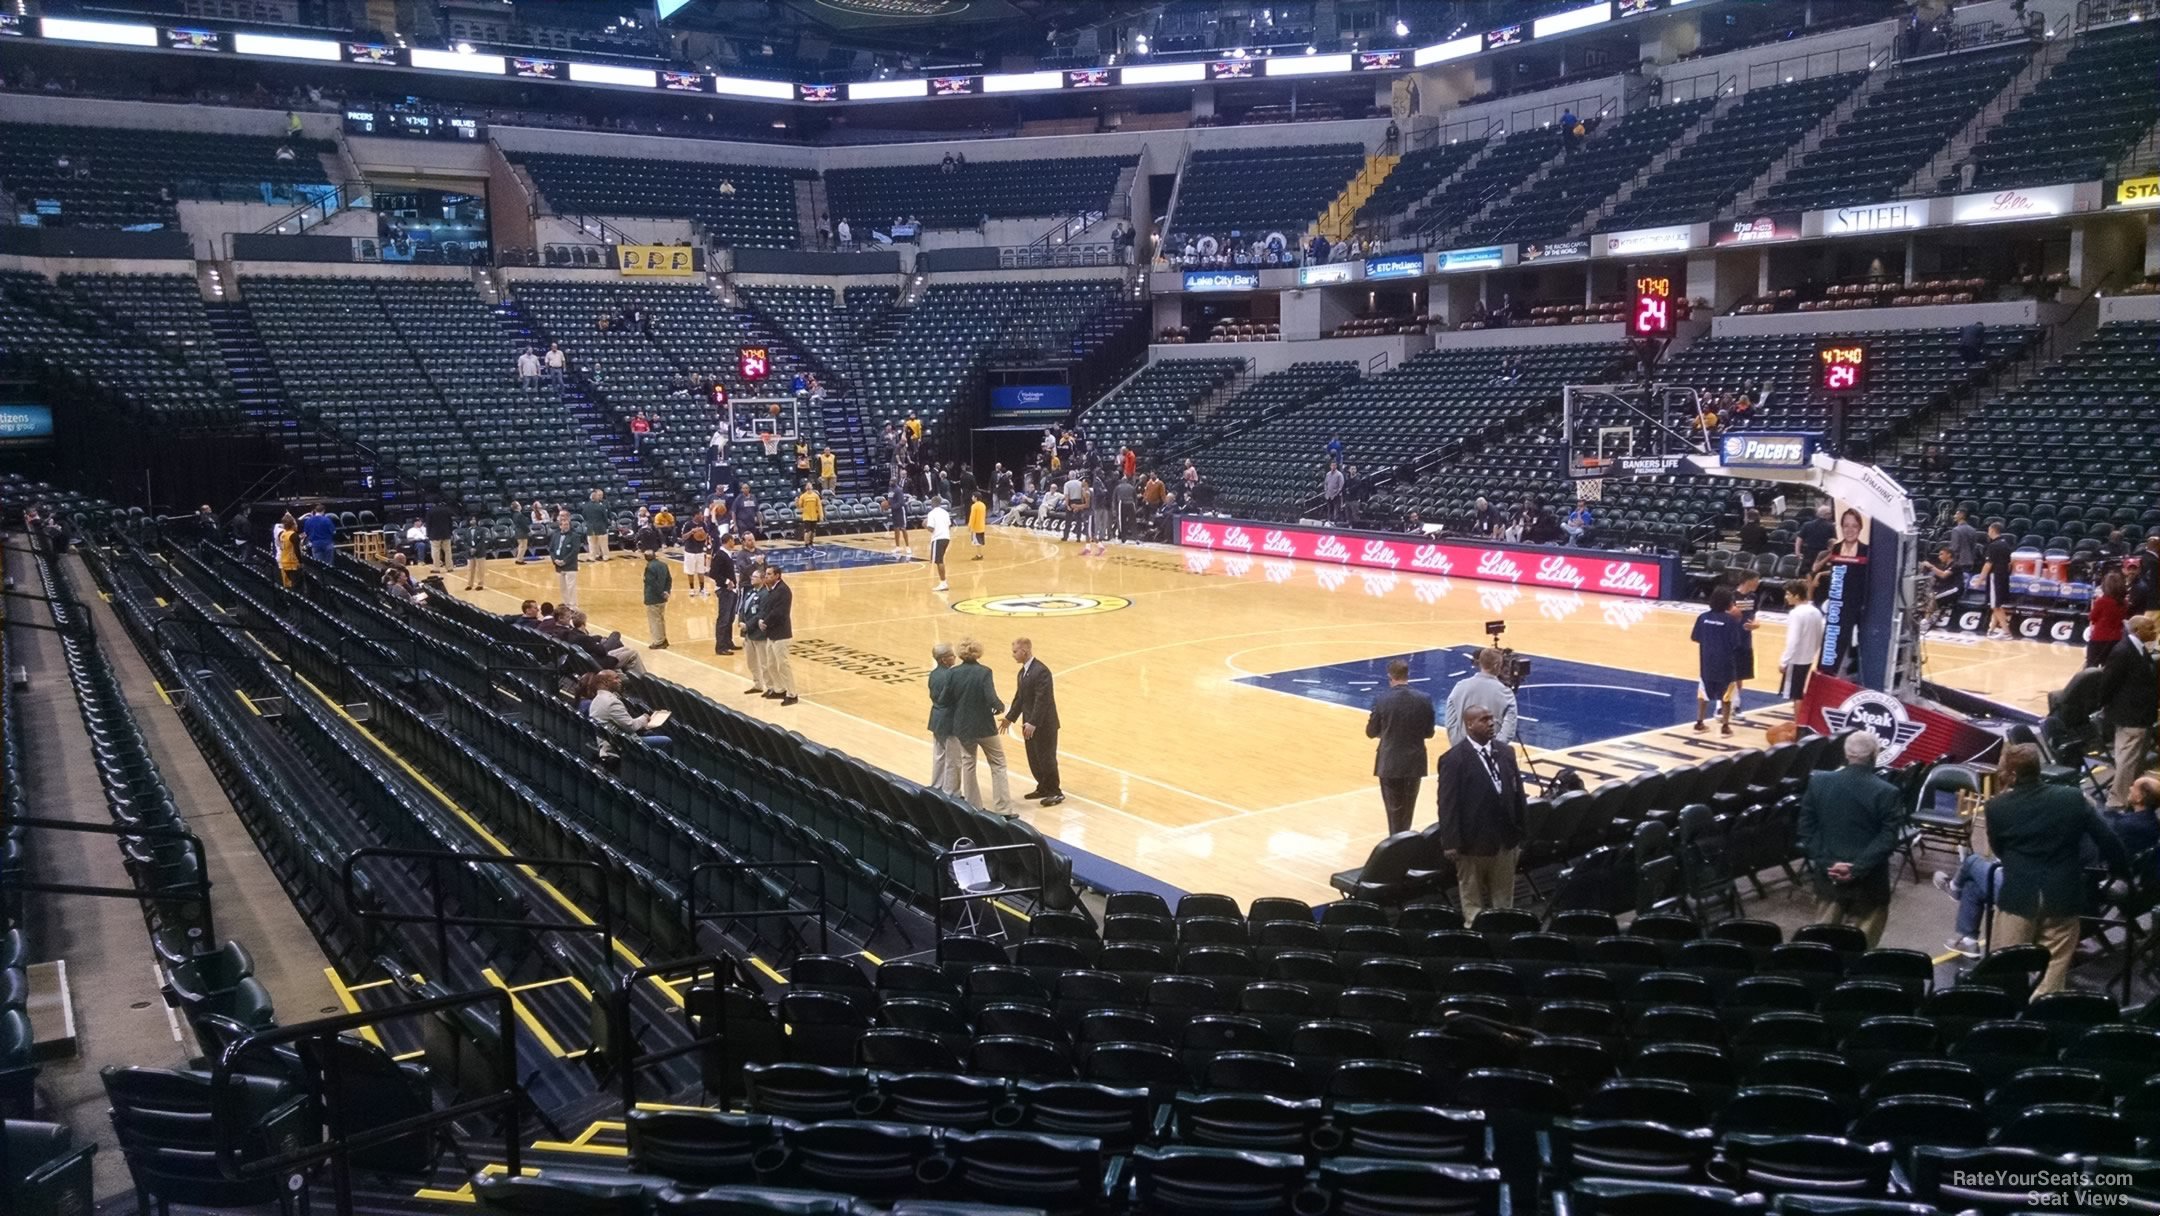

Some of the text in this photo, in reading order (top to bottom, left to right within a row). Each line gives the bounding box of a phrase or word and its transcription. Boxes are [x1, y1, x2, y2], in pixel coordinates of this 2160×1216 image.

[348, 111, 374, 121] PACERS
[365, 122, 373, 131] 0
[451, 119, 476, 128] WOLVES
[468, 129, 475, 138] 0
[1990, 191, 2034, 212] Lilly
[1733, 222, 1753, 233] the
[1377, 263, 1391, 272] ETC
[1191, 275, 1258, 288] Lake City Bank
[1638, 277, 1669, 297] 47:40
[1639, 298, 1666, 331] 24
[741, 349, 765, 359] 47:40
[1822, 348, 1862, 364] 47:40
[745, 358, 764, 376] 24
[1829, 366, 1854, 387] 24
[16, 423, 36, 432] group
[1745, 440, 1802, 461] Pacers
[1622, 459, 1679, 469] BANKERS LIFE
[1862, 472, 1893, 503] SPALDING
[1185, 523, 1214, 548] Lilly
[1222, 527, 1254, 551] Lilly
[1263, 531, 1296, 556] Lilly
[1314, 536, 1350, 562] Lilly
[1361, 540, 1400, 568] Lilly
[1411, 545, 1453, 574] Lilly
[1477, 551, 1522, 582] Lilly
[1536, 556, 1584, 588] Lilly
[1600, 562, 1653, 596] Lilly
[1959, 611, 1982, 630] G
[2020, 617, 2043, 637] G
[2051, 621, 2075, 640] G
[796, 638, 905, 668] BANKERS
[1821, 624, 1841, 666] Honda
[1851, 706, 1893, 728] Steak
